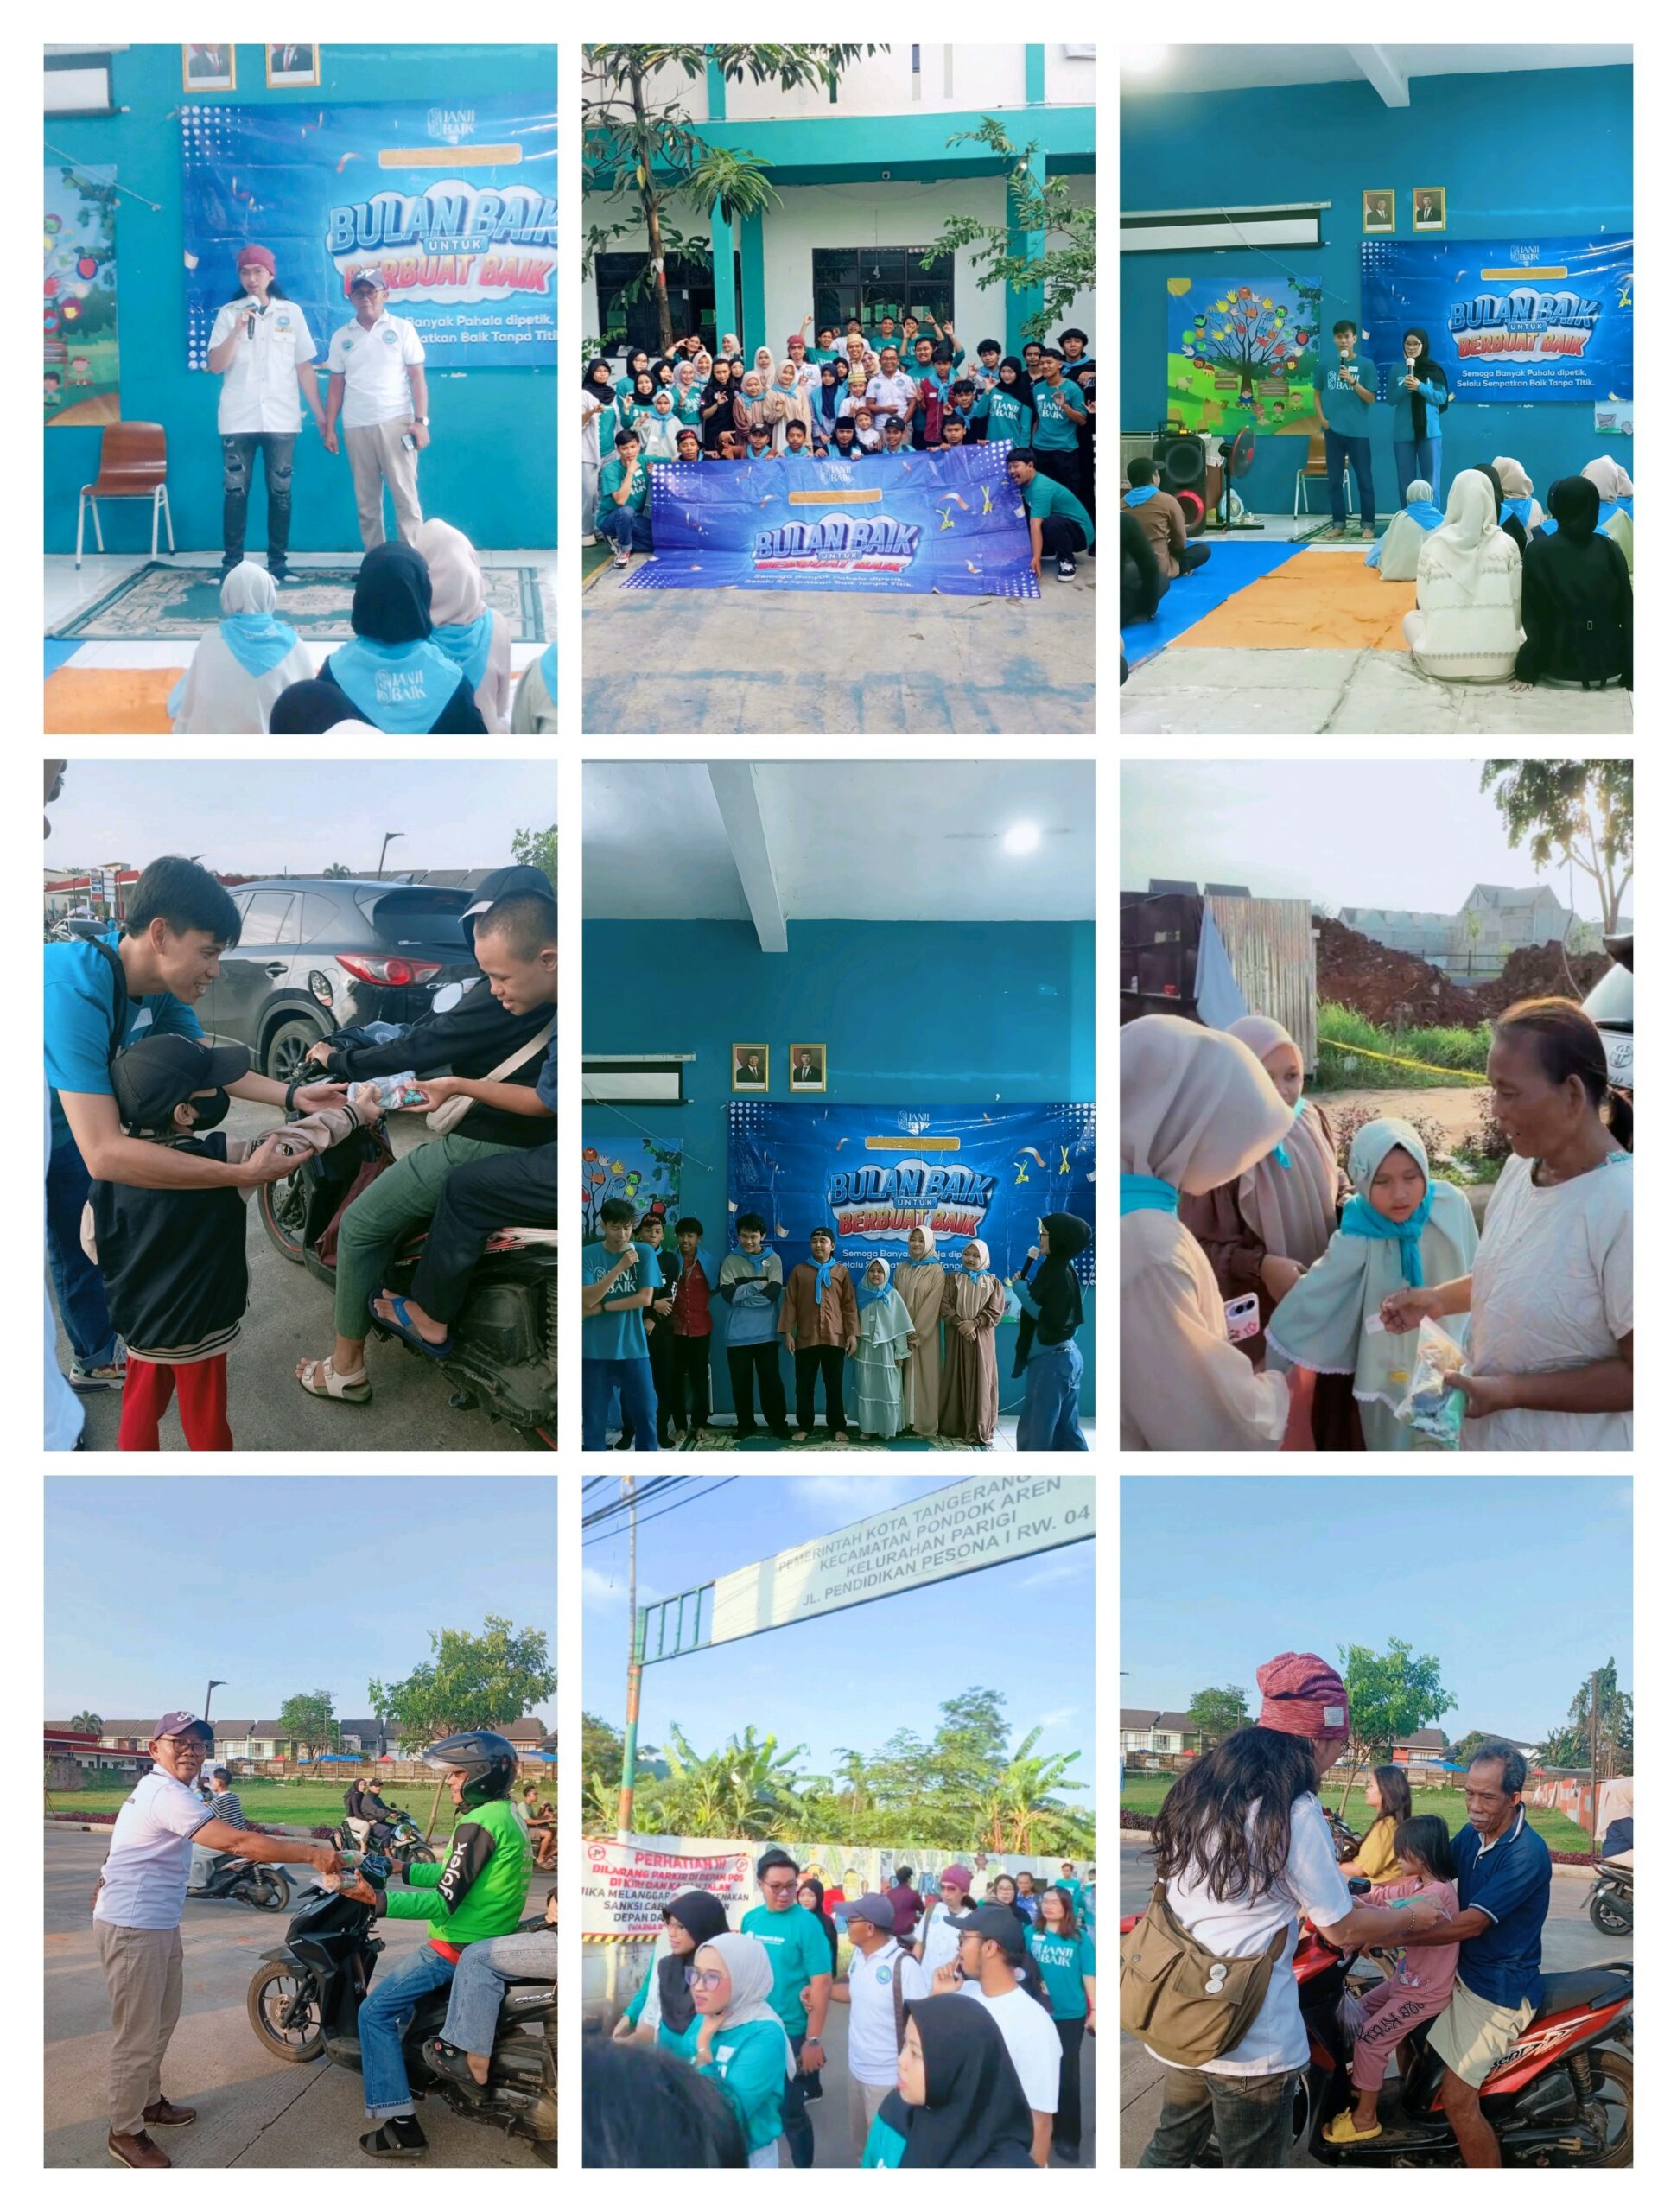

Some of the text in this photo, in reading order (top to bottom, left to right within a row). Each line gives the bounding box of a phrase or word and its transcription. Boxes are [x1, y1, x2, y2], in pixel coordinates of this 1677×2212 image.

[443, 110, 475, 123] JANJI
[329, 195, 558, 254] BULAN BAIK
[429, 239, 481, 251] UNTUK
[478, 256, 555, 292] BAIK
[456, 315, 503, 327] Pahala
[1450, 296, 1600, 331] BULAN BAIK
[461, 331, 489, 343] Baik
[491, 330, 532, 345] Tanpa
[1458, 333, 1588, 358] BERBUAT BAIK
[1462, 370, 1494, 378] Semoga
[1496, 369, 1525, 378] Banyak
[1483, 379, 1528, 388] Sempatkan
[1548, 379, 1573, 388] Tanpa
[755, 523, 919, 559] BULAN BAIK
[908, 1112, 930, 1121] JANJI
[830, 1169, 995, 1207] BULAN BAIK
[838, 1209, 981, 1236] BERBUAT BAIK
[842, 1249, 879, 1259] Semoga
[820, 1476, 1062, 1572] KECAMATAN PONDOK AREN
[778, 1533, 862, 1573] PEMERINTAH
[866, 1516, 908, 1541] KOTA
[846, 1510, 1017, 1578] KELURAHAN PARIGI
[803, 1504, 1090, 1606] JL. PENDIDIKAN PESONA I RW. 04
[635, 1851, 713, 1870] PERHATIAN
[592, 1864, 650, 1878] DILARANG
[651, 1871, 689, 1881] PARKIR
[698, 1873, 727, 1882] DEPAN
[728, 1873, 744, 1882] POS
[609, 1878, 622, 1887] DI
[645, 1880, 667, 1890] DAN
[603, 1900, 643, 1911] SANKSI
[613, 1912, 649, 1922] DEPAN
[1042, 1944, 1073, 1958] JANJI
[1040, 1953, 1071, 1967] BAIK
